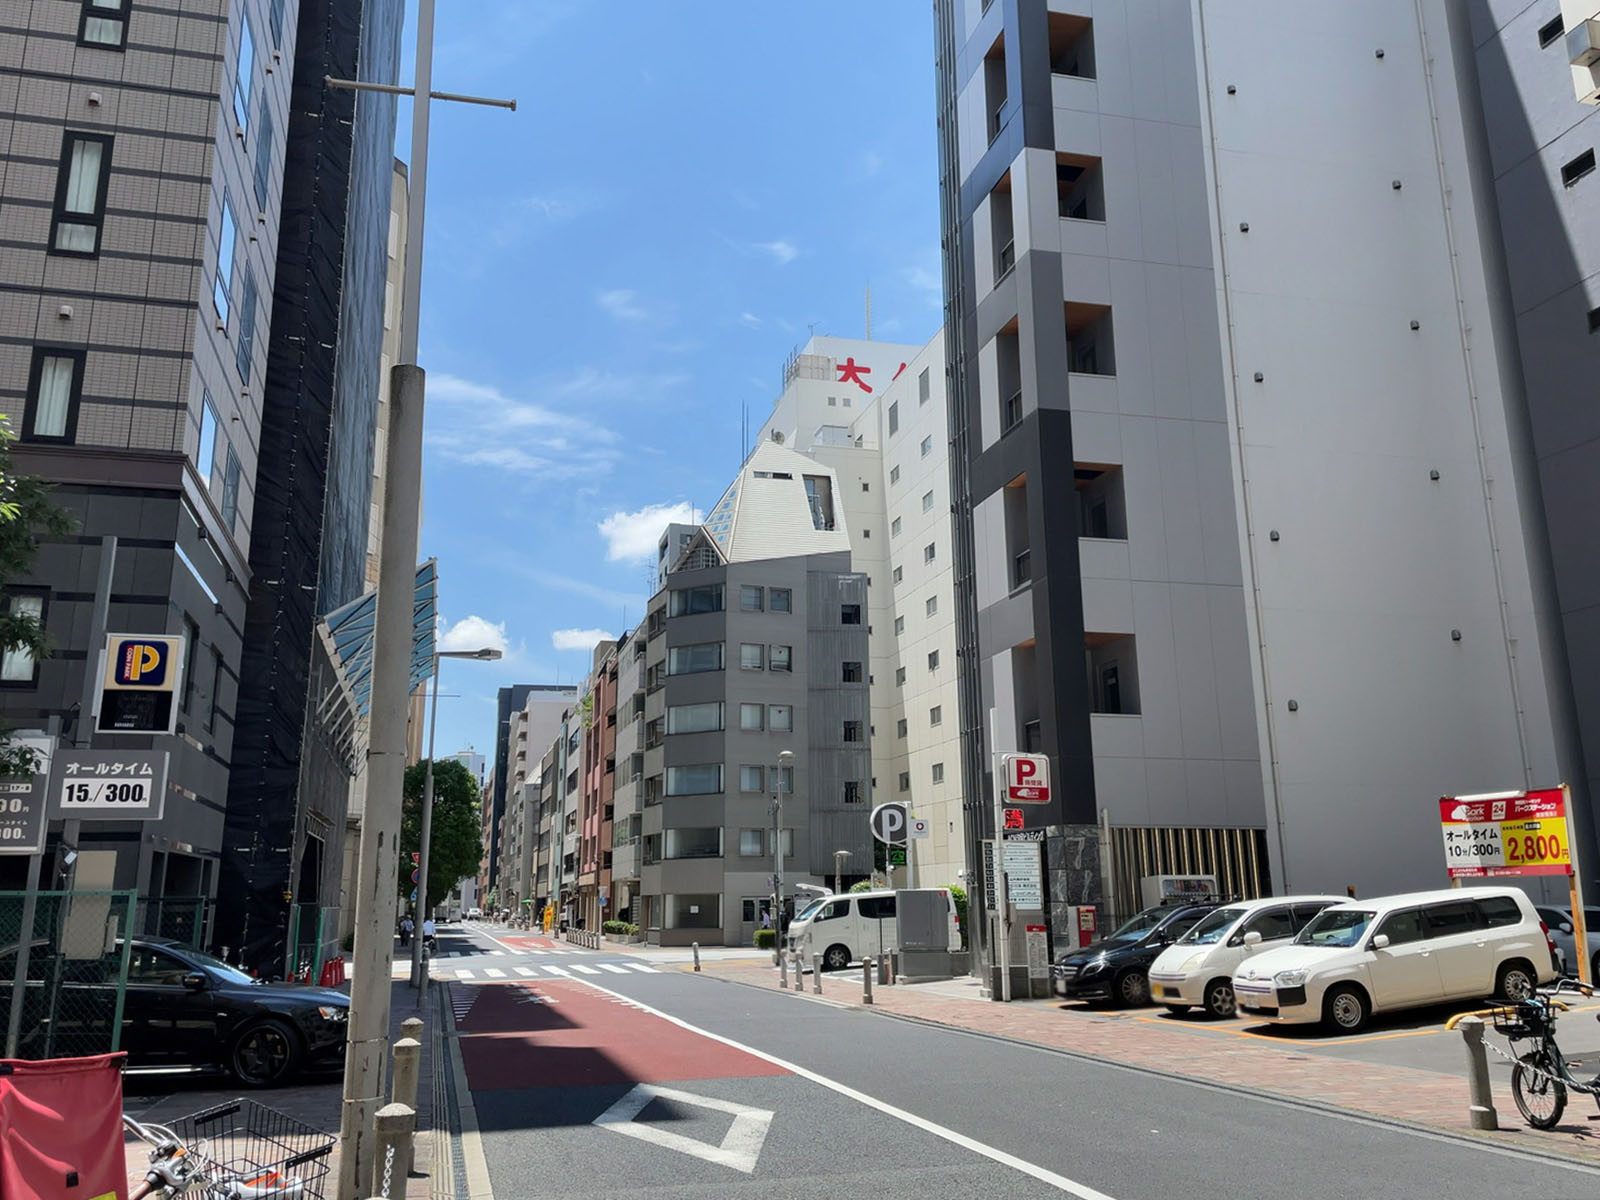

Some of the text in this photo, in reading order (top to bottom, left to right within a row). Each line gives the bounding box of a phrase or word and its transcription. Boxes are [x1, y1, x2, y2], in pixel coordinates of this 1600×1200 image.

[129, 644, 160, 681] P
[66, 762, 153, 775] オールタイム
[1016, 759, 1037, 786] P
[881, 808, 904, 842] P
[1446, 828, 1498, 842] オールタイム
